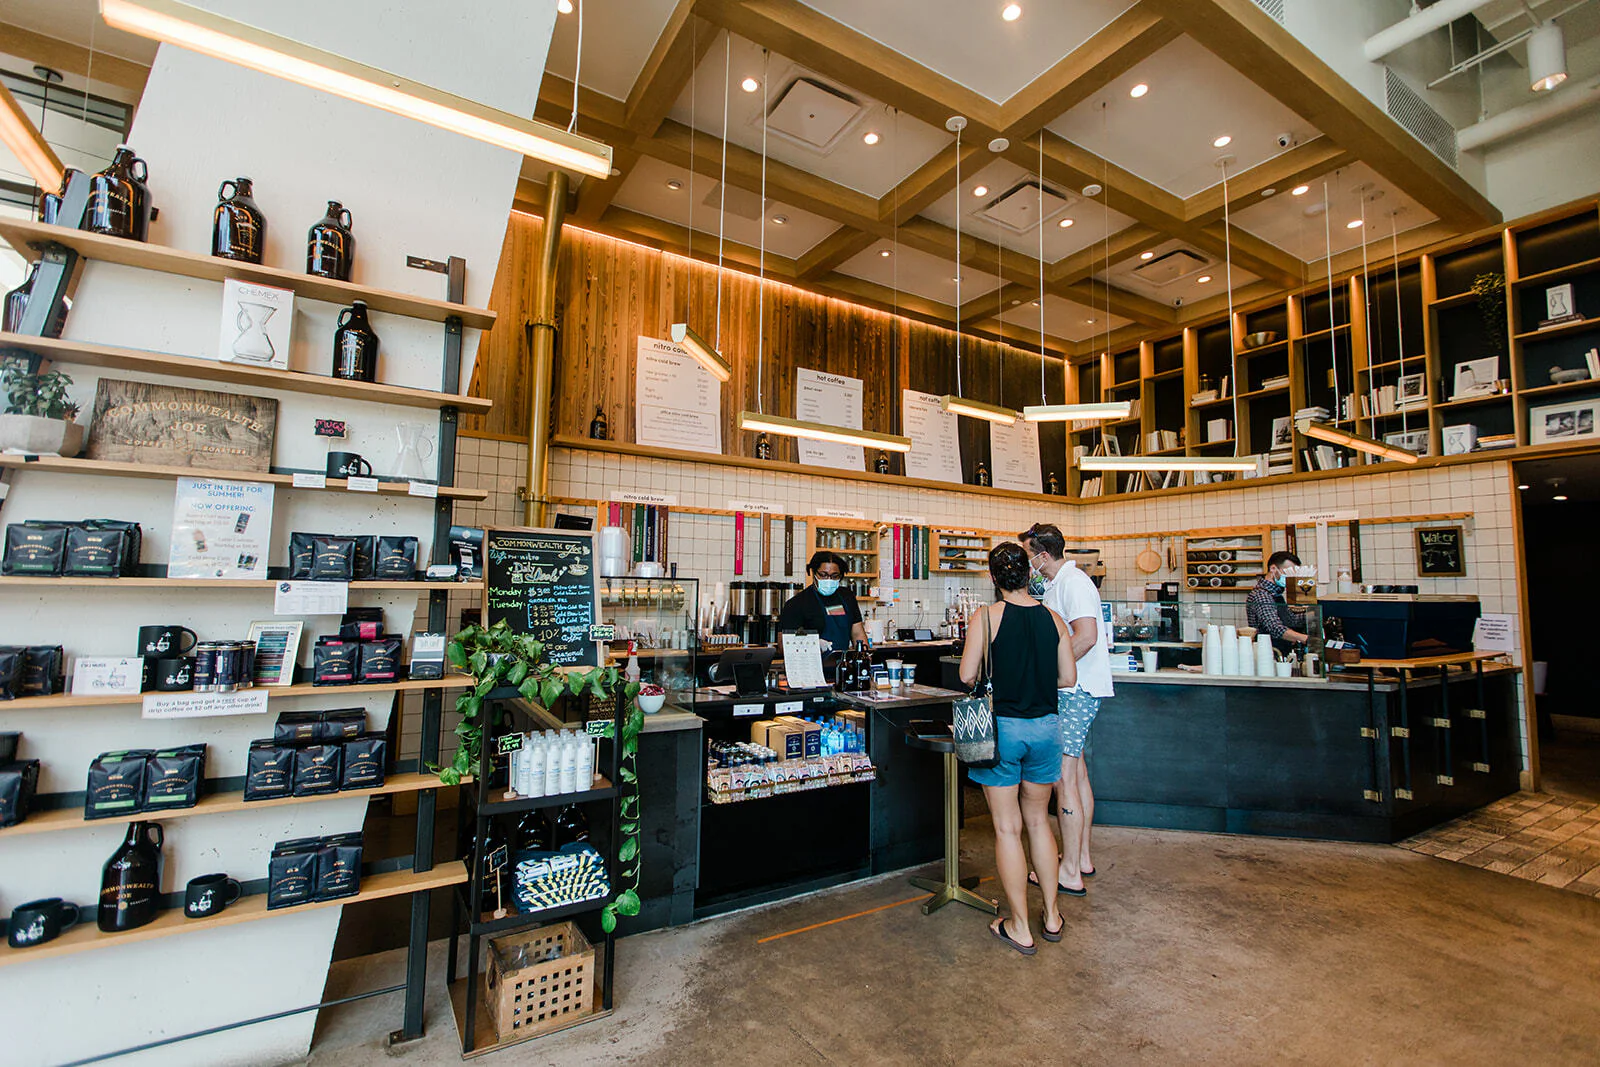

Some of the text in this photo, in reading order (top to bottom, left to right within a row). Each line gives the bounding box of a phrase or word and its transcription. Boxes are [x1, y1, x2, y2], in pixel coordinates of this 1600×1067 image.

[238, 286, 279, 300] CHEMEX
[653, 343, 671, 351] nitro
[827, 377, 845, 385] coffee
[107, 401, 263, 433] COMMONWEALTH
[170, 421, 207, 434] JOE
[315, 420, 344, 432] MUGS
[497, 539, 563, 550] COMMONWEALTH
